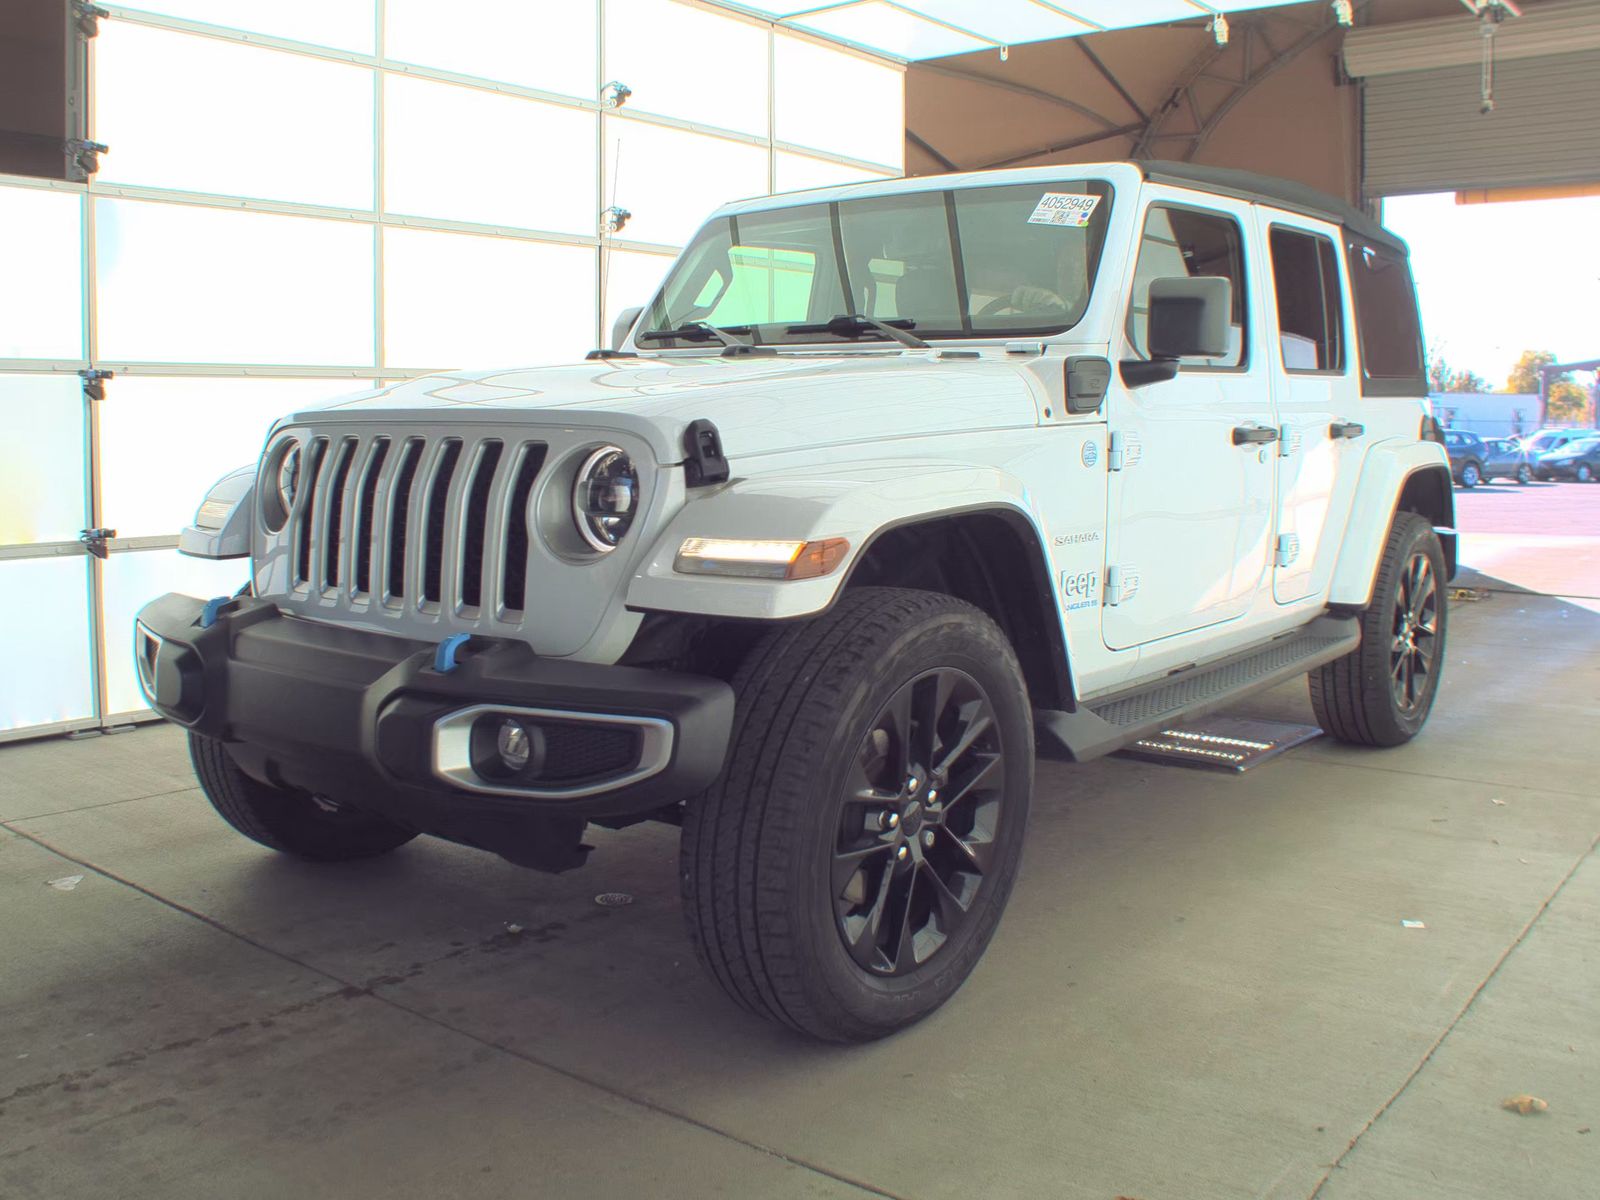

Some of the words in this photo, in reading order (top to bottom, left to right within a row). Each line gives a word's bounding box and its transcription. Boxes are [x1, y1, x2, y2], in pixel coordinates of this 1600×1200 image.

[1041, 196, 1094, 211] 4052949
[1054, 530, 1100, 547] SAHARA
[1061, 570, 1096, 599] Jeep
